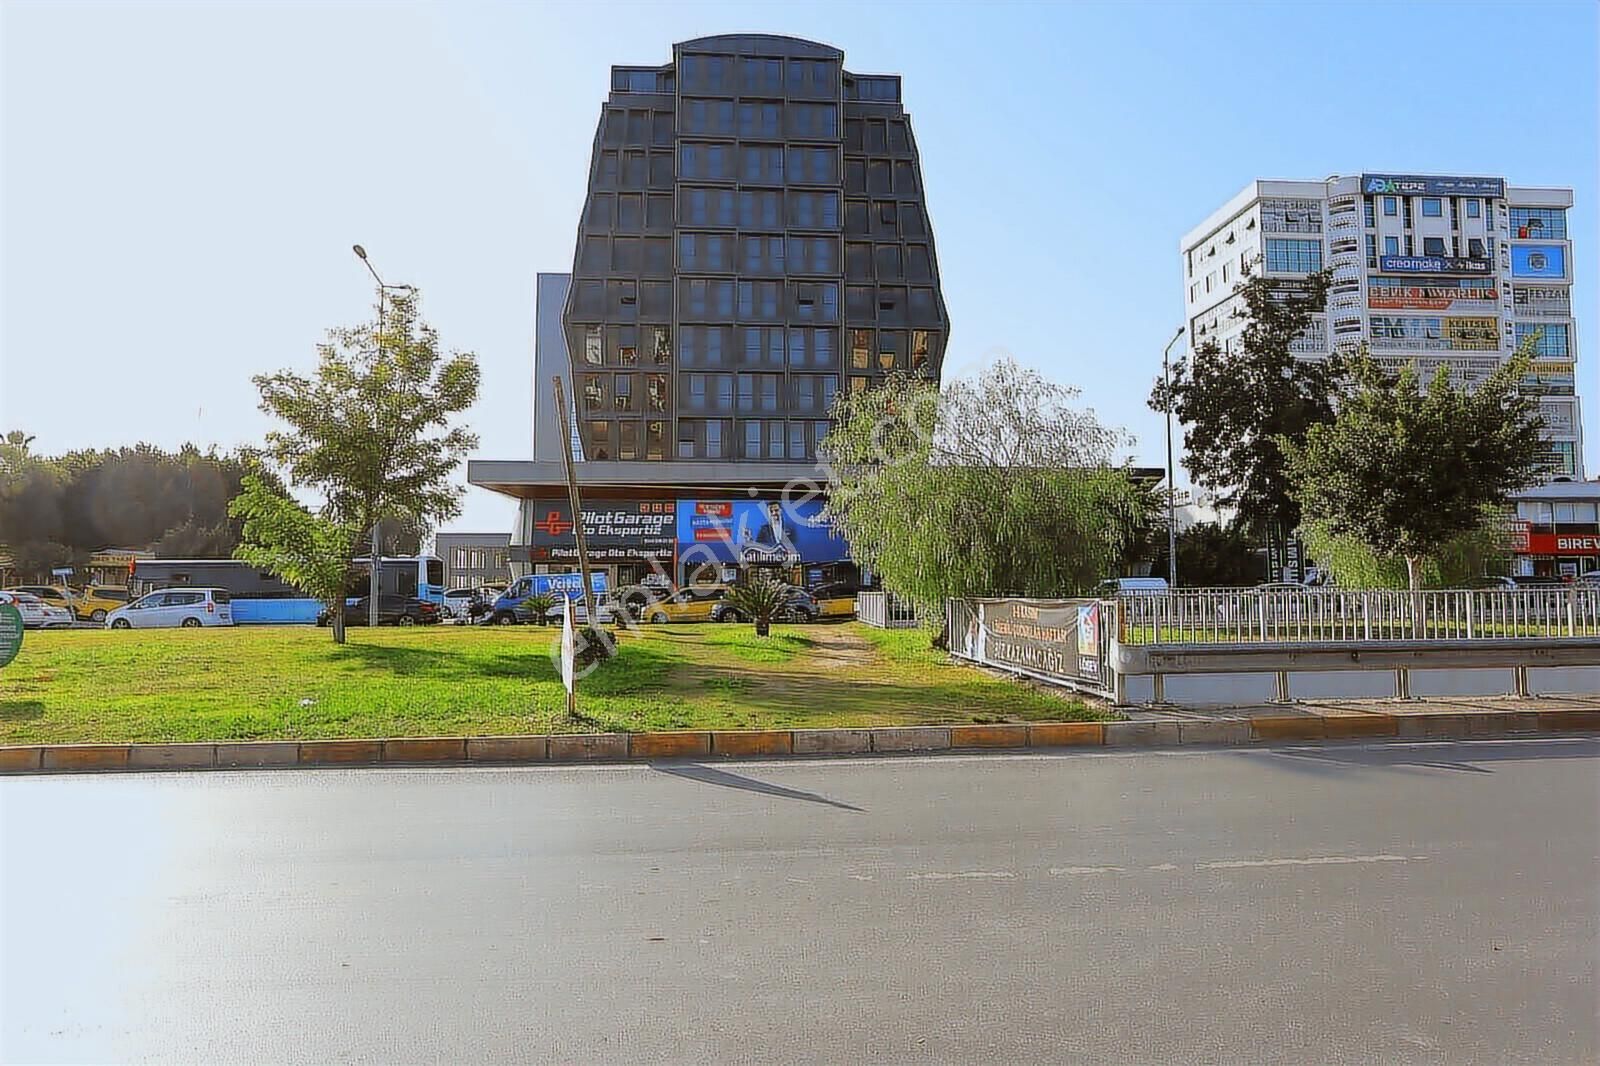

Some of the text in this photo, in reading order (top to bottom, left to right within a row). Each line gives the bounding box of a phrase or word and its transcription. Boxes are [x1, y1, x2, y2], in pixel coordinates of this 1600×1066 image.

[597, 525, 662, 537] Ekspertiz
[551, 548, 673, 559] PilotGrage Oto Ekspertiz
